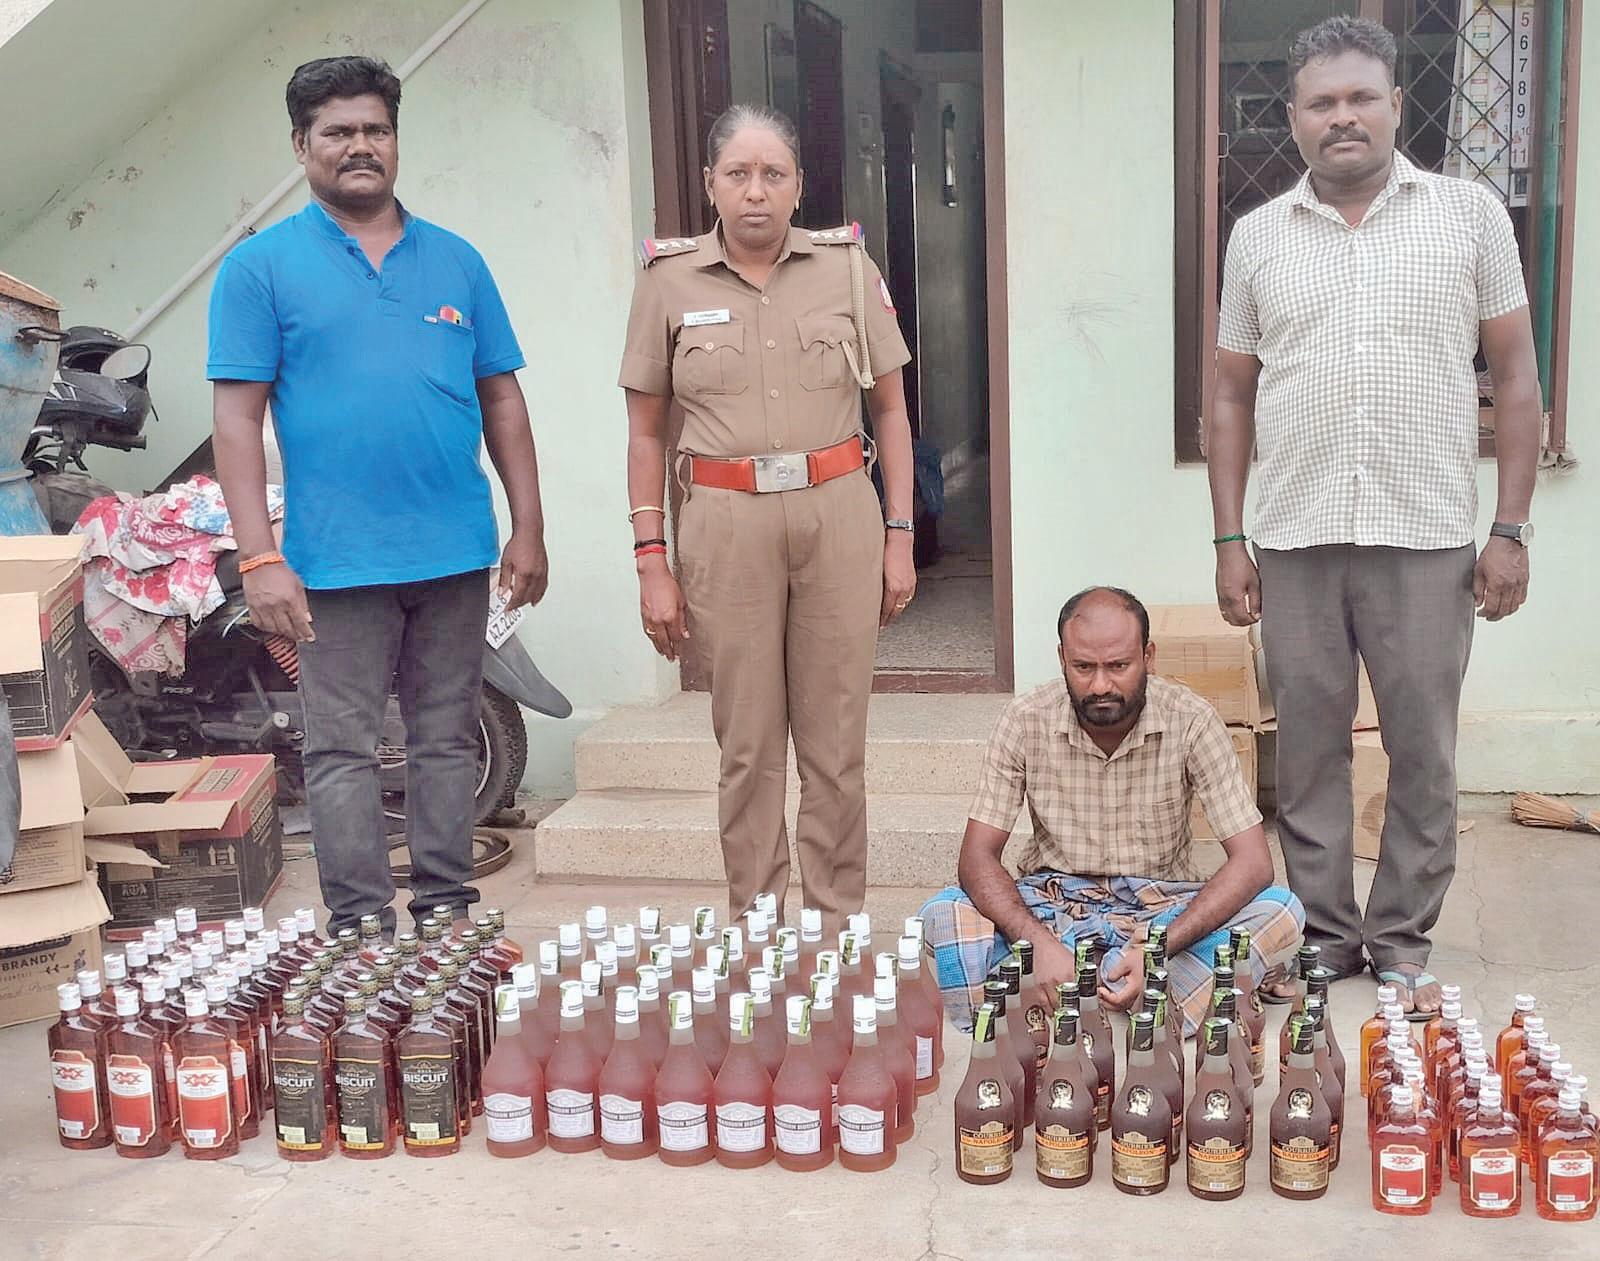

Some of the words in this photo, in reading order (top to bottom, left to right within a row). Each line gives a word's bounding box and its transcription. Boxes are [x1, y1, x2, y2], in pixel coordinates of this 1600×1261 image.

[1521, 12, 1529, 27] 5
[1520, 35, 1528, 50] 6
[1519, 58, 1528, 73] 7
[1518, 81, 1526, 96] 8
[1517, 104, 1525, 118] 9
[1511, 148, 1526, 164] 11
[2, 952, 56, 971] BRANDY
[274, 1075, 315, 1087] BISCUIT
[336, 1075, 376, 1087] BISCUIT
[403, 1072, 448, 1083] BISCUIT
